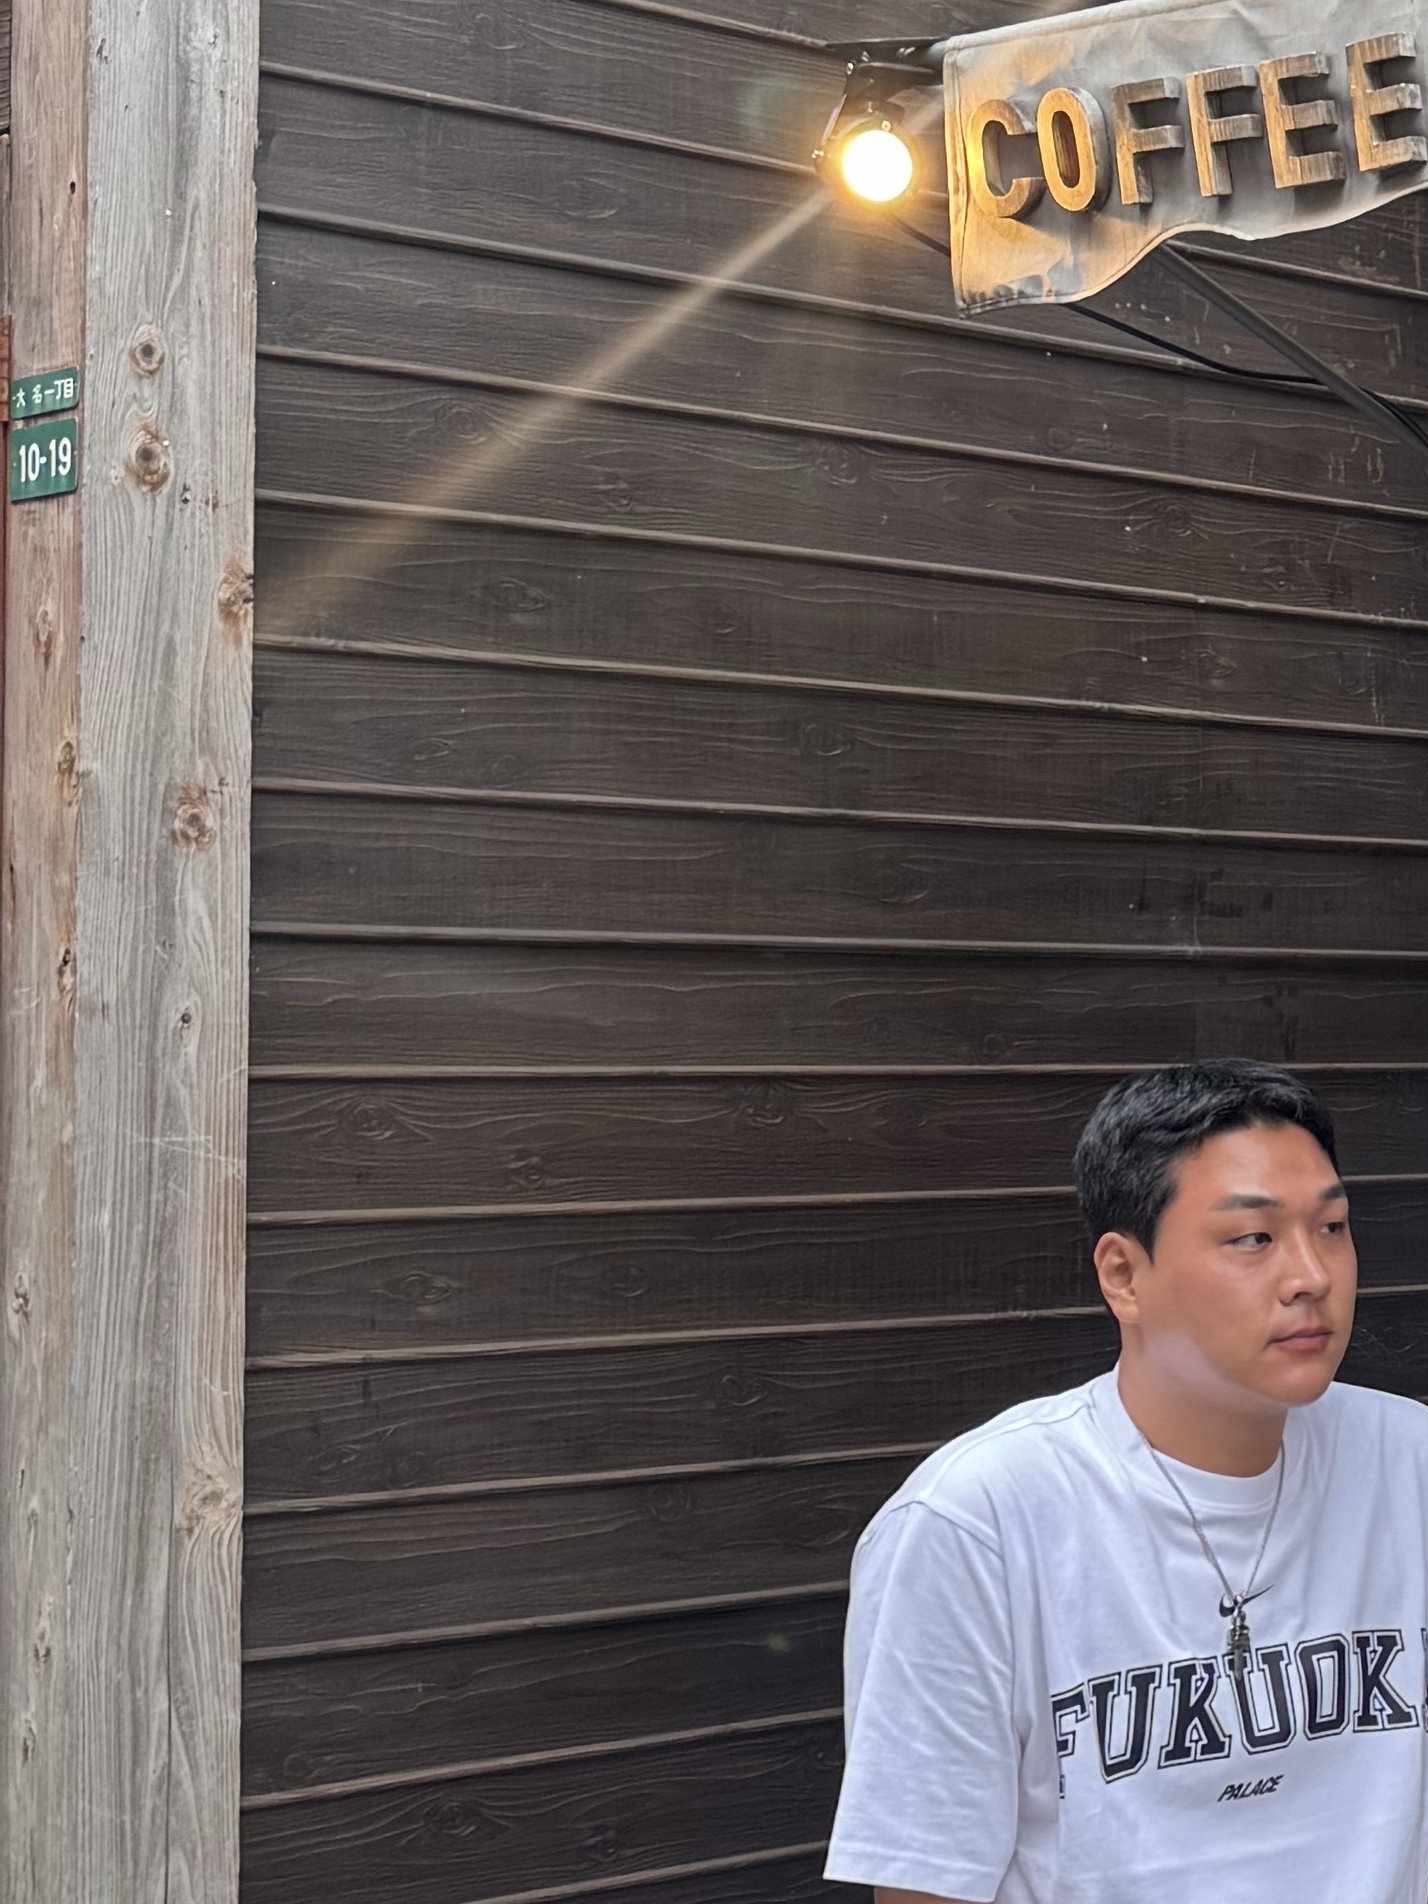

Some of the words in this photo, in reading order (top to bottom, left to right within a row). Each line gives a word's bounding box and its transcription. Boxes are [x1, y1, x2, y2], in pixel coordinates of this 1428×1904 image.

[967, 31, 1428, 219] COFFEE
[16, 377, 74, 408] 大名一丁目
[19, 436, 72, 483] 10-19
[1217, 1774, 1284, 1802] PALACE
